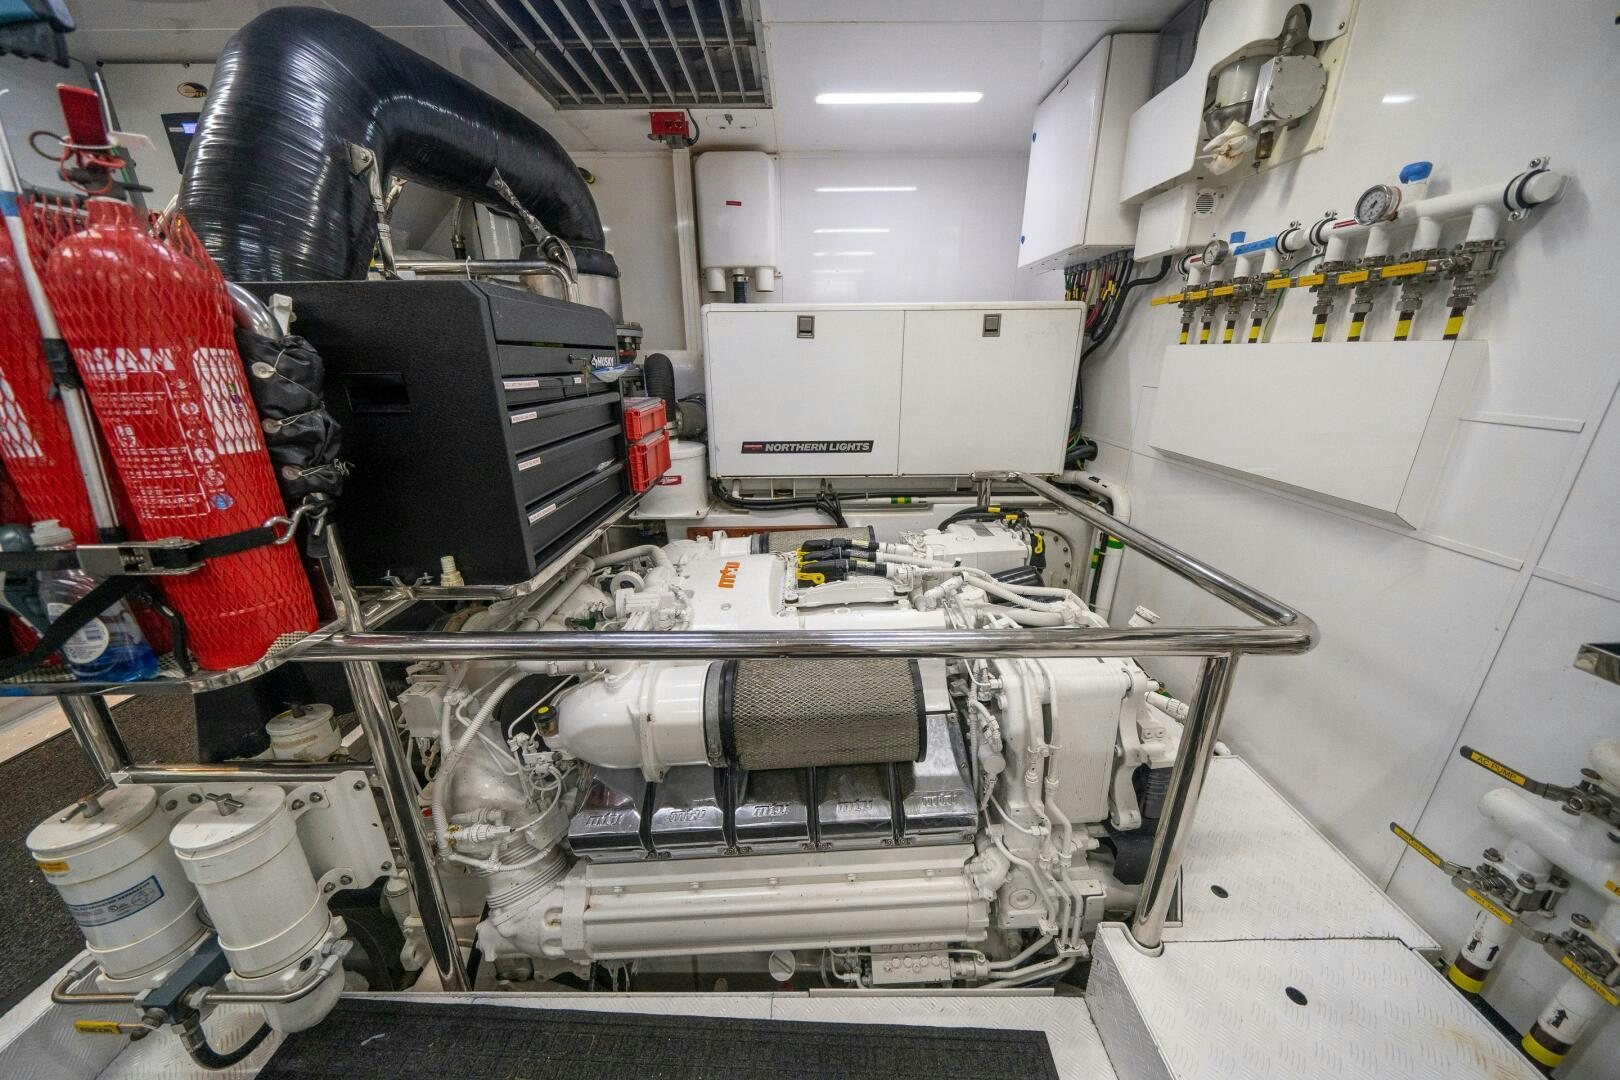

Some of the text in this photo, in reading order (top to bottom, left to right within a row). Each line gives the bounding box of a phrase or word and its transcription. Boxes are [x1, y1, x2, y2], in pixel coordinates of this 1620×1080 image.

[596, 355, 615, 367] HUSKY
[764, 441, 870, 452] NORTHERN LIGHTS
[1477, 755, 1517, 780] AC PUMP
